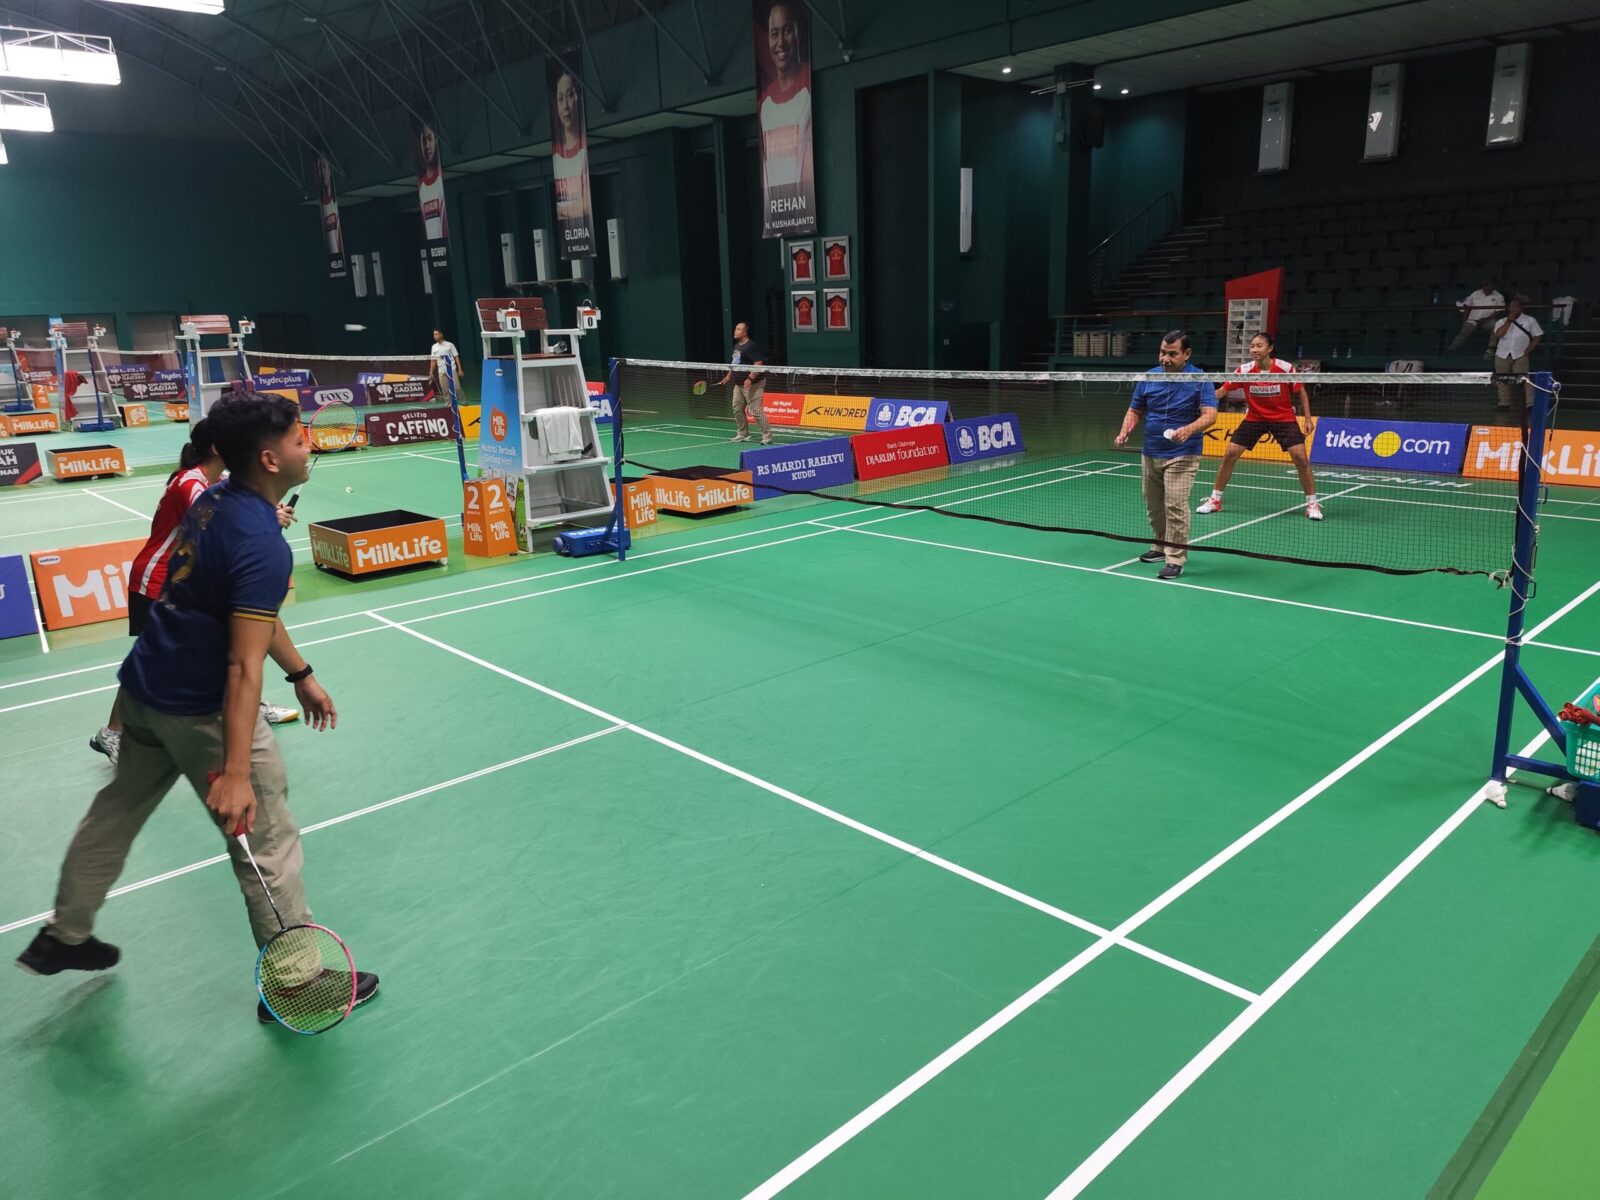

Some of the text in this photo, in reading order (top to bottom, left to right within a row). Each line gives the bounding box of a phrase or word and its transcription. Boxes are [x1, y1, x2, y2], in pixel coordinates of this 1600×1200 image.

[770, 195, 806, 214] REHAN
[564, 227, 590, 241] GLORIA
[510, 317, 518, 329] 0
[587, 316, 594, 328] 0
[402, 412, 427, 421] DELIZIO
[823, 406, 867, 418] HUNDRED
[894, 405, 937, 427] BCA
[386, 418, 449, 442] CAFFINO
[978, 421, 1016, 451] BCA
[757, 453, 845, 476] RS MARDI RAHAYU
[865, 444, 940, 466] DJARUM foundation
[59, 457, 121, 474] MilkLife
[791, 469, 816, 480] KUDUS
[467, 485, 480, 509] 2
[487, 484, 504, 509] 2
[631, 491, 653, 510] Milk
[655, 487, 691, 508] ilkLife
[697, 483, 750, 508] MilkLife
[635, 506, 656, 525] Life
[467, 522, 482, 534] Milk
[490, 520, 508, 533] Milk
[493, 529, 510, 541] Life
[469, 532, 483, 542] Life
[313, 538, 350, 568] MilkLife
[356, 535, 442, 568] MilkLife
